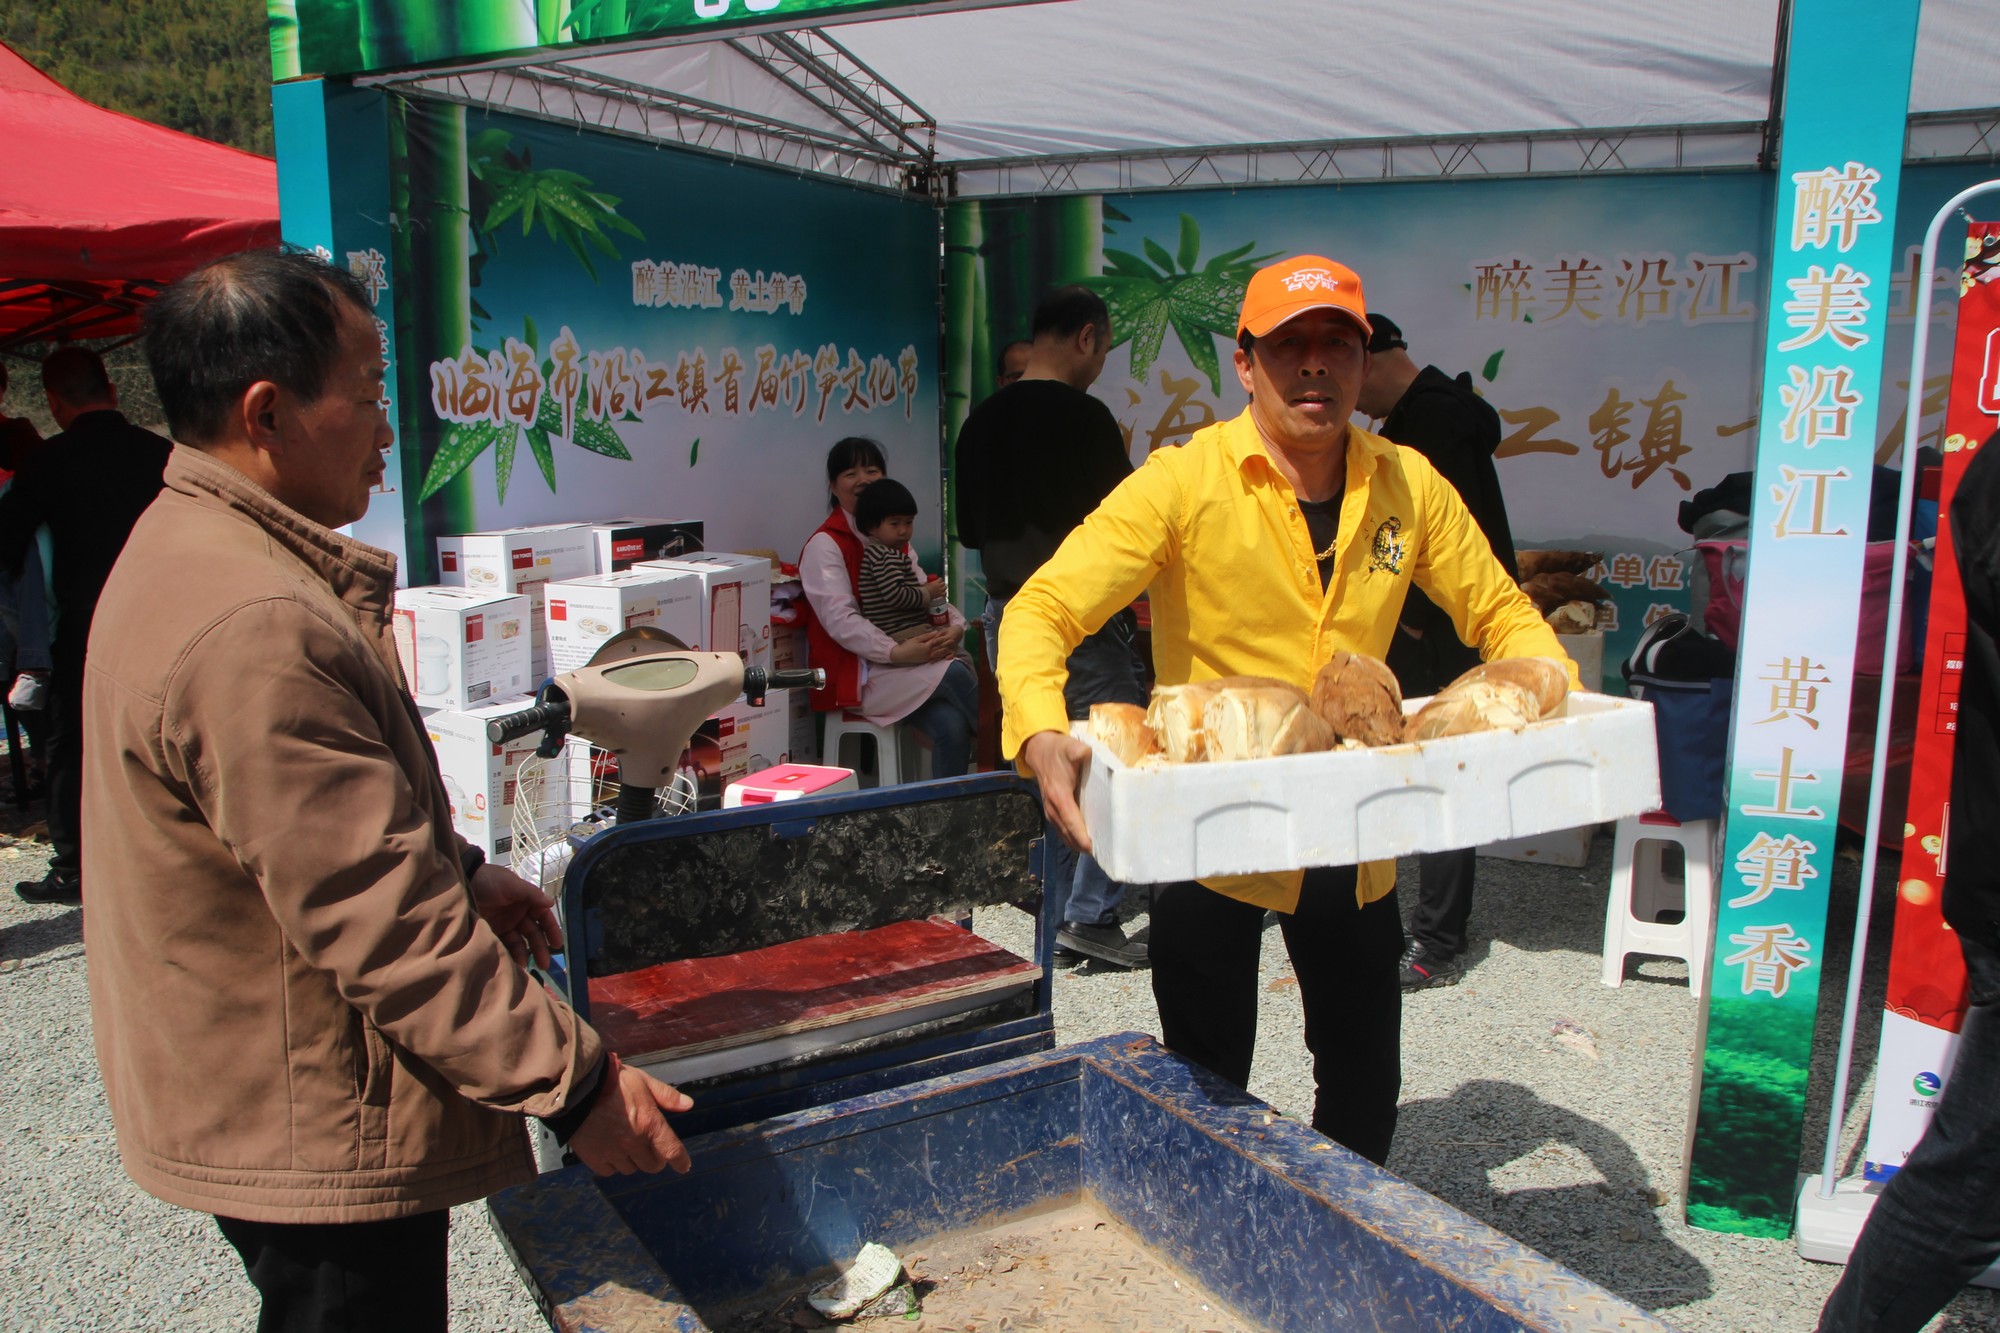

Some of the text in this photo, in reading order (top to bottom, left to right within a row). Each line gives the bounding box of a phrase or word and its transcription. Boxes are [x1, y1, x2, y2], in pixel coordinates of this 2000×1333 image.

[634, 264, 805, 314] 醉美沿江 黄土笋香
[1473, 256, 1753, 322] 醉美沿江
[432, 331, 919, 437] 临海市沿江镇首届竹笋文化节
[1728, 164, 1881, 996] 醉美沿江 黄土笋香
